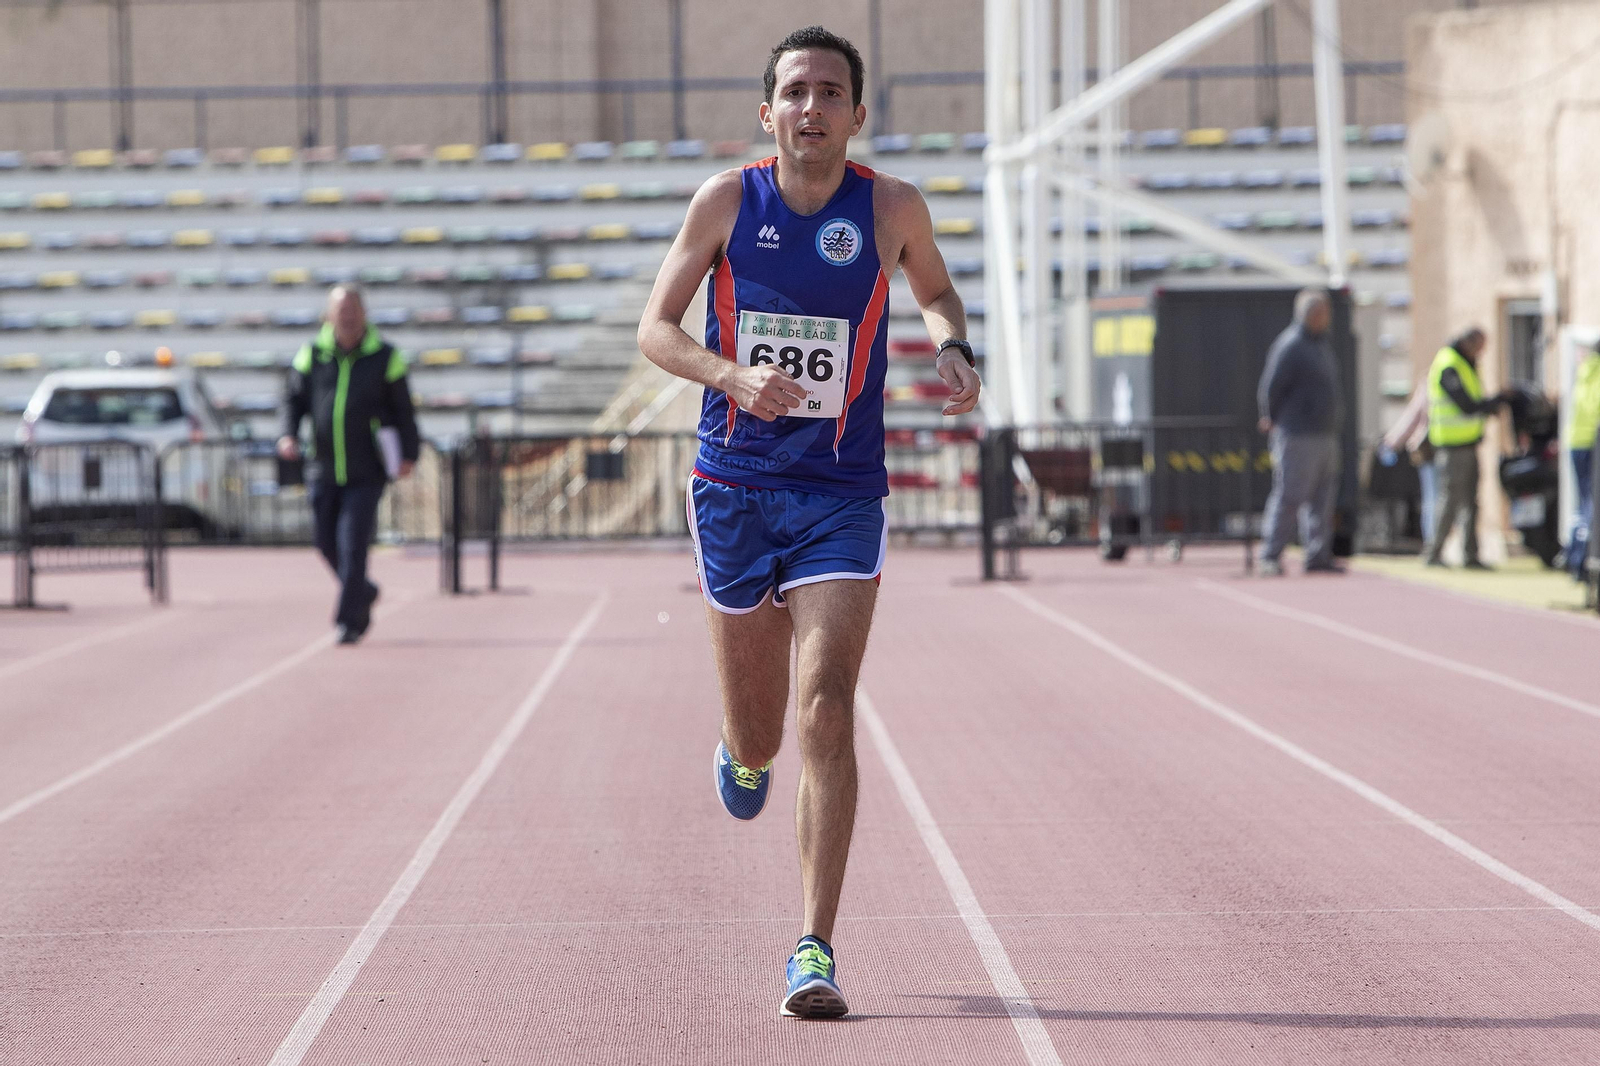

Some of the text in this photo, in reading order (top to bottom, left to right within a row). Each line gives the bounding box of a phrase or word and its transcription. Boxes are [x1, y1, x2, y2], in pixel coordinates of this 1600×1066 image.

[756, 241, 780, 249] mobel
[776, 318, 798, 326] MEDIA
[752, 325, 837, 340] BAHÍA DE CÁDIZ
[749, 343, 834, 382] 686
[808, 400, 821, 410] Dd
